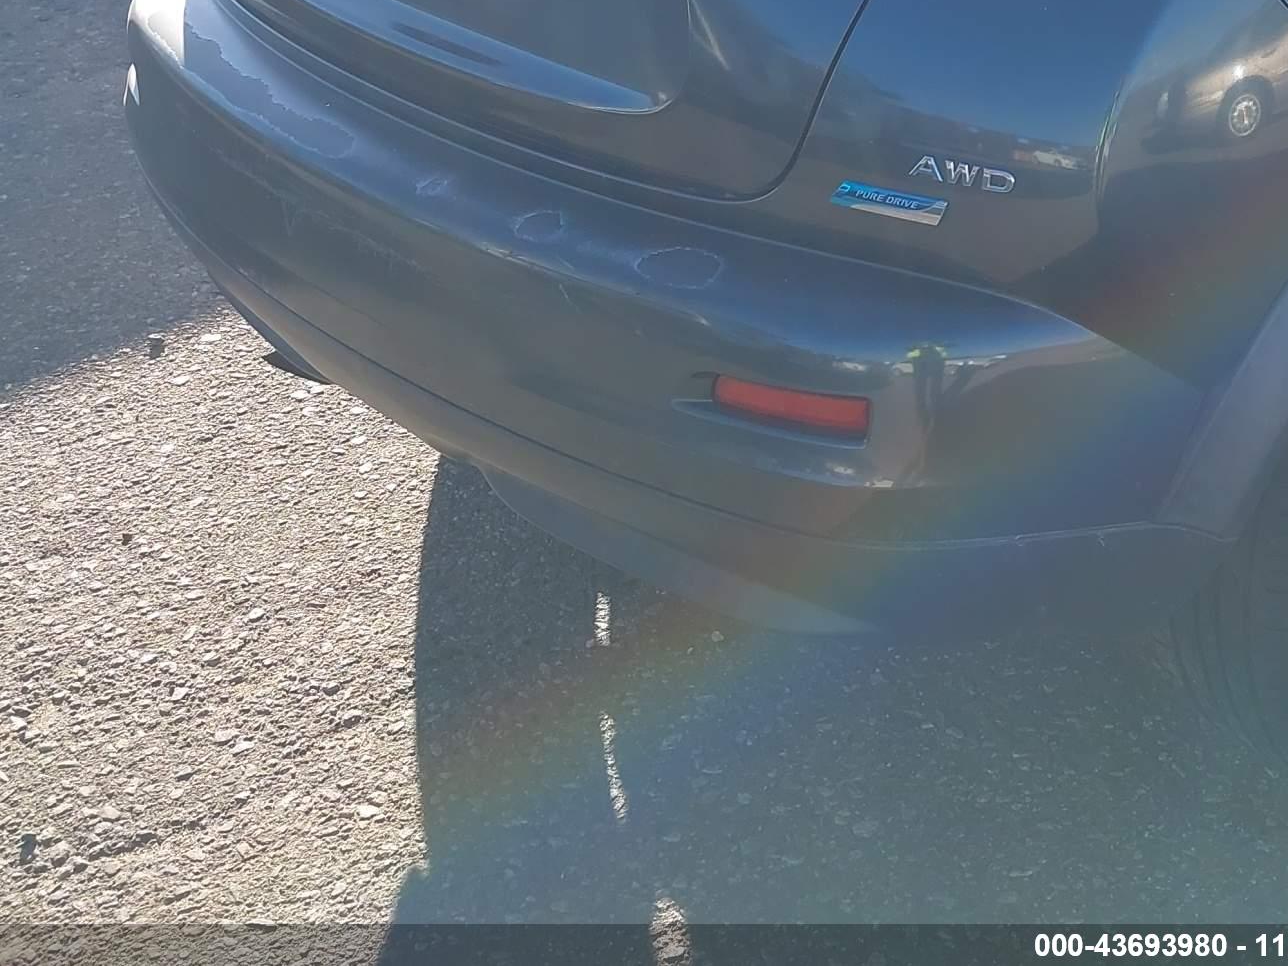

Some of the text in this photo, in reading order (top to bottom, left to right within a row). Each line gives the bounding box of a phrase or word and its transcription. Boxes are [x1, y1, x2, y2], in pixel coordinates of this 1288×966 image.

[909, 155, 1016, 193] AWD
[856, 189, 919, 210] PURE DRIVE
